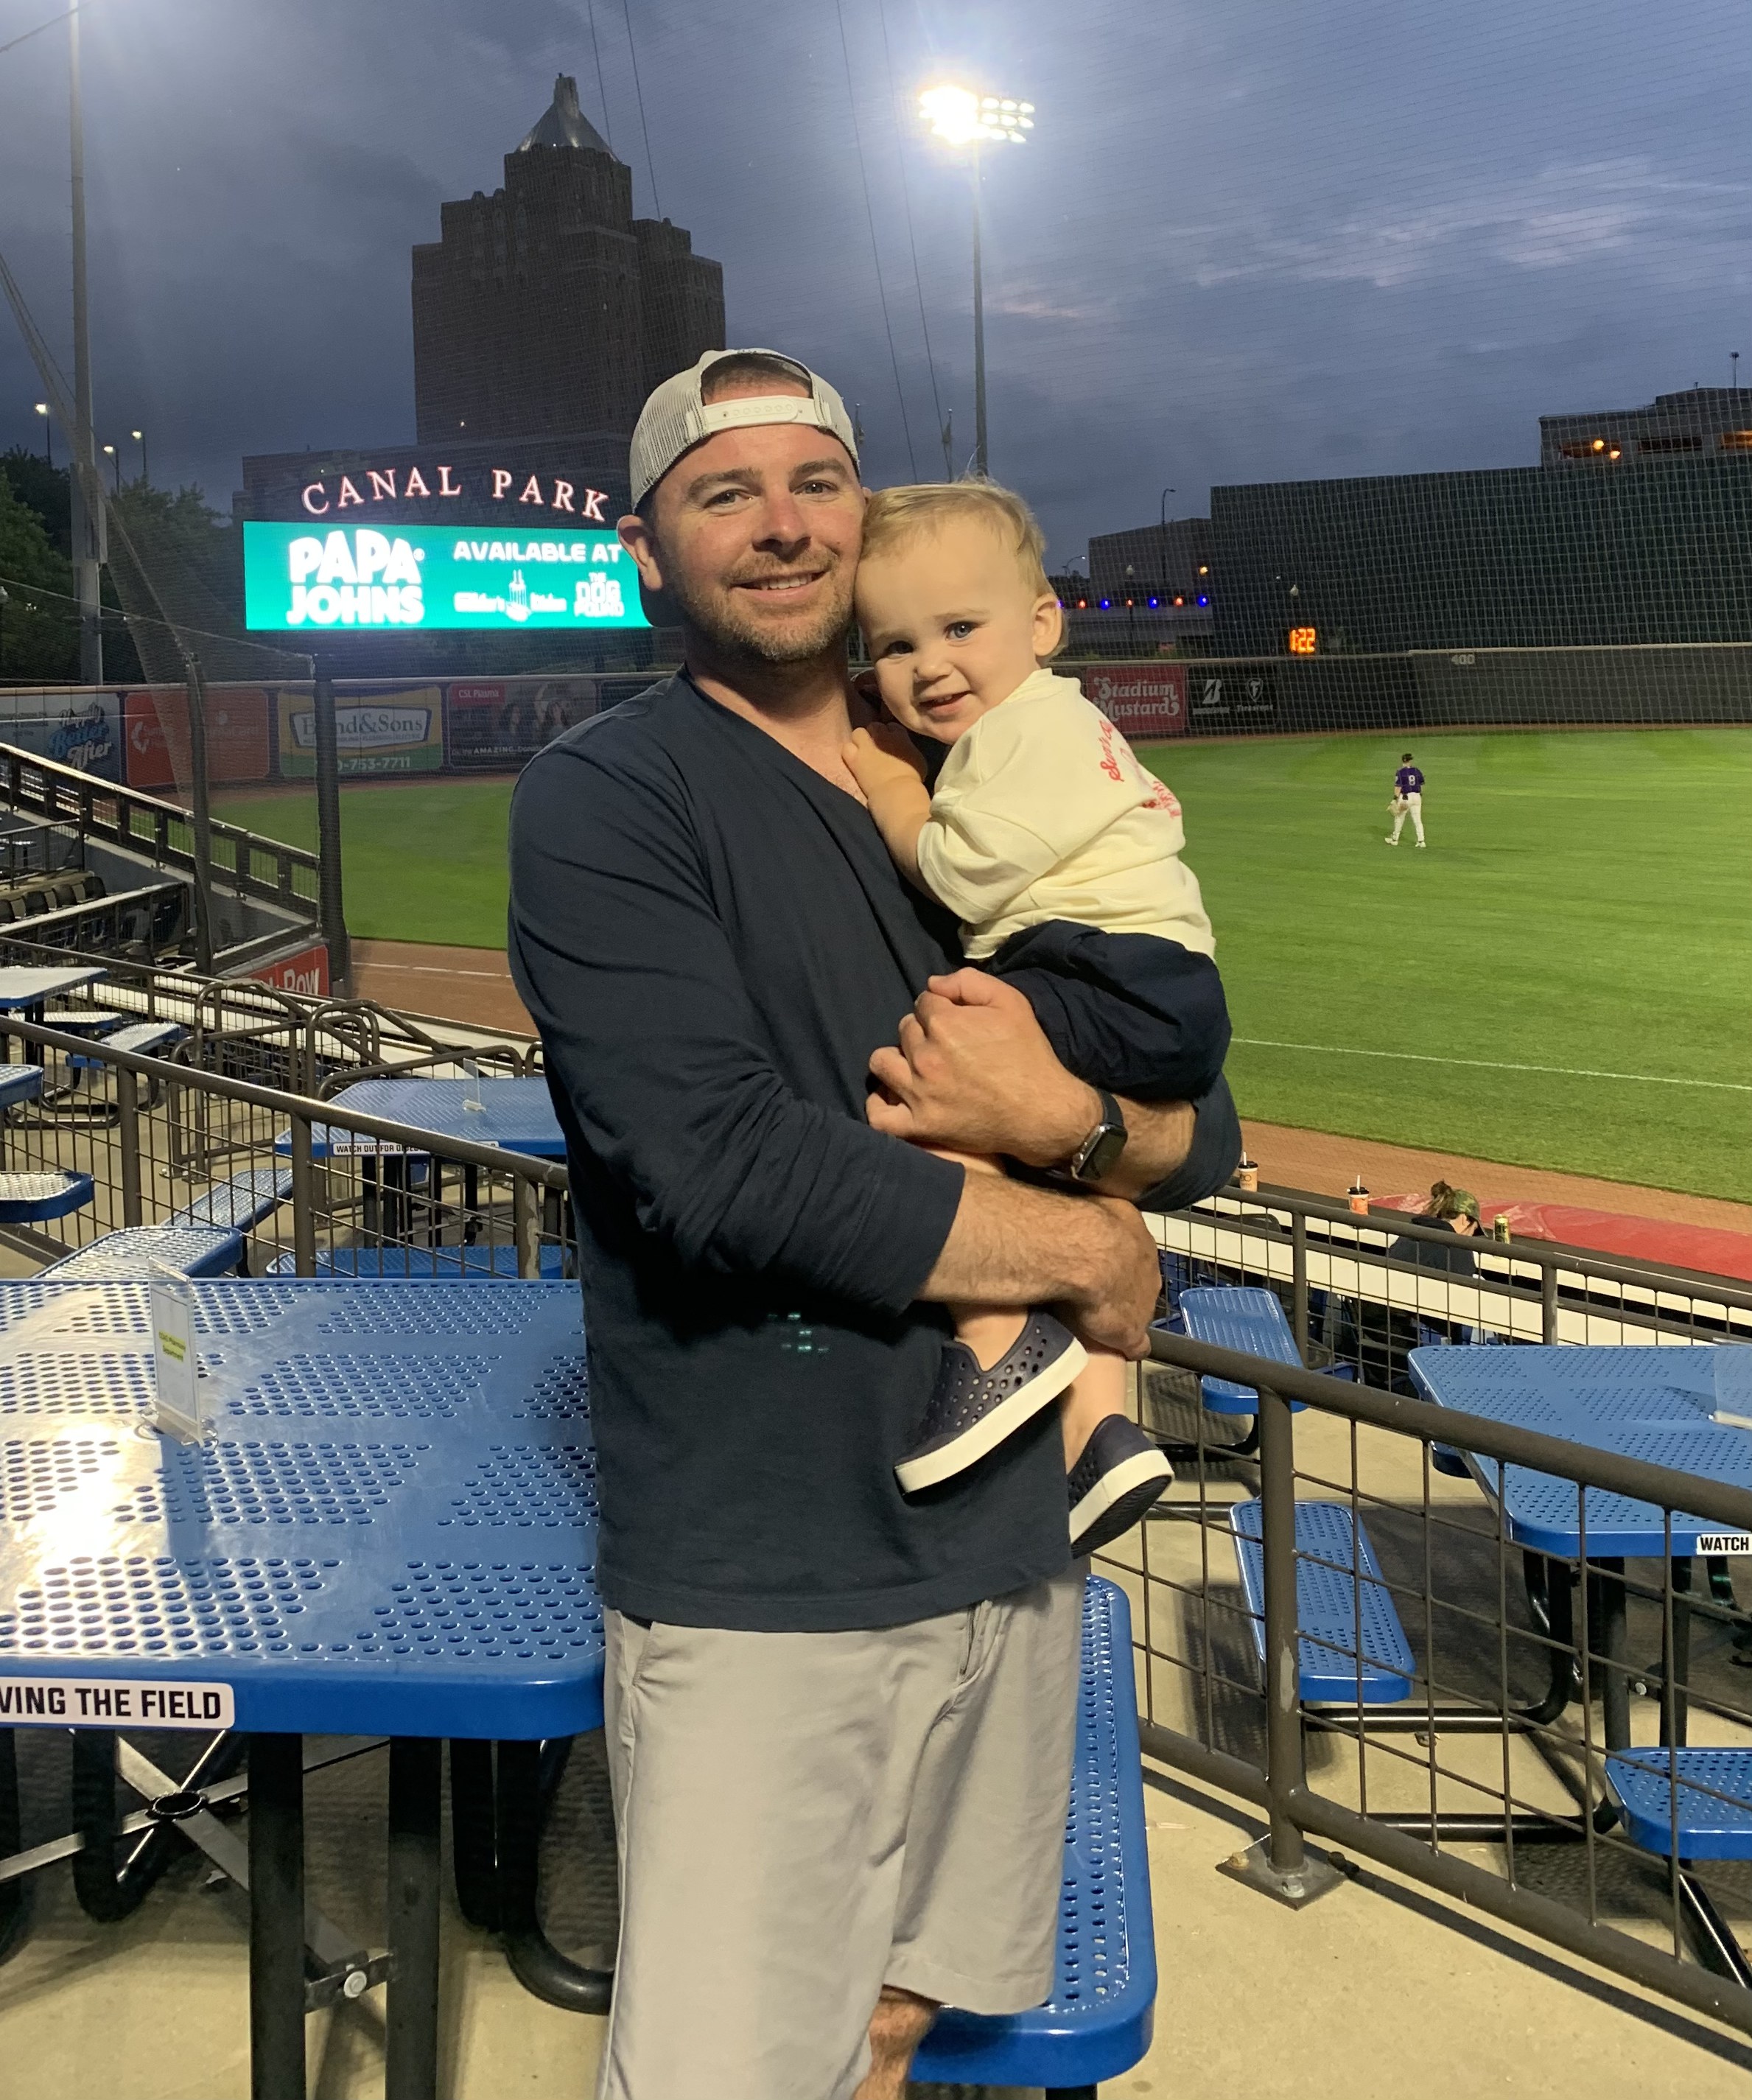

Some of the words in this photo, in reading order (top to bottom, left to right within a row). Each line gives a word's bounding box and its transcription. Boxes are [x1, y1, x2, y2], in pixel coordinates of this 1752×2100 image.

[301, 466, 461, 515] CANAL
[492, 469, 610, 522] PARK
[289, 529, 422, 583] PAPA
[452, 542, 586, 561] AVAILABLE
[592, 544, 622, 563] AT
[576, 581, 621, 602] DOG
[286, 585, 425, 625] JOHNS
[1290, 629, 1316, 653] 1:22
[1451, 654, 1475, 665] 400
[459, 690, 472, 698] CSL
[474, 690, 500, 698] Plasma
[1093, 677, 1178, 701] Stadium
[1093, 699, 1179, 721] Mustard
[67, 739, 112, 769] After
[473, 746, 514, 755] AMAZING
[1700, 1537, 1749, 1550] WATCH
[75, 1688, 131, 1717] THE
[141, 1690, 220, 1719] FIELD
